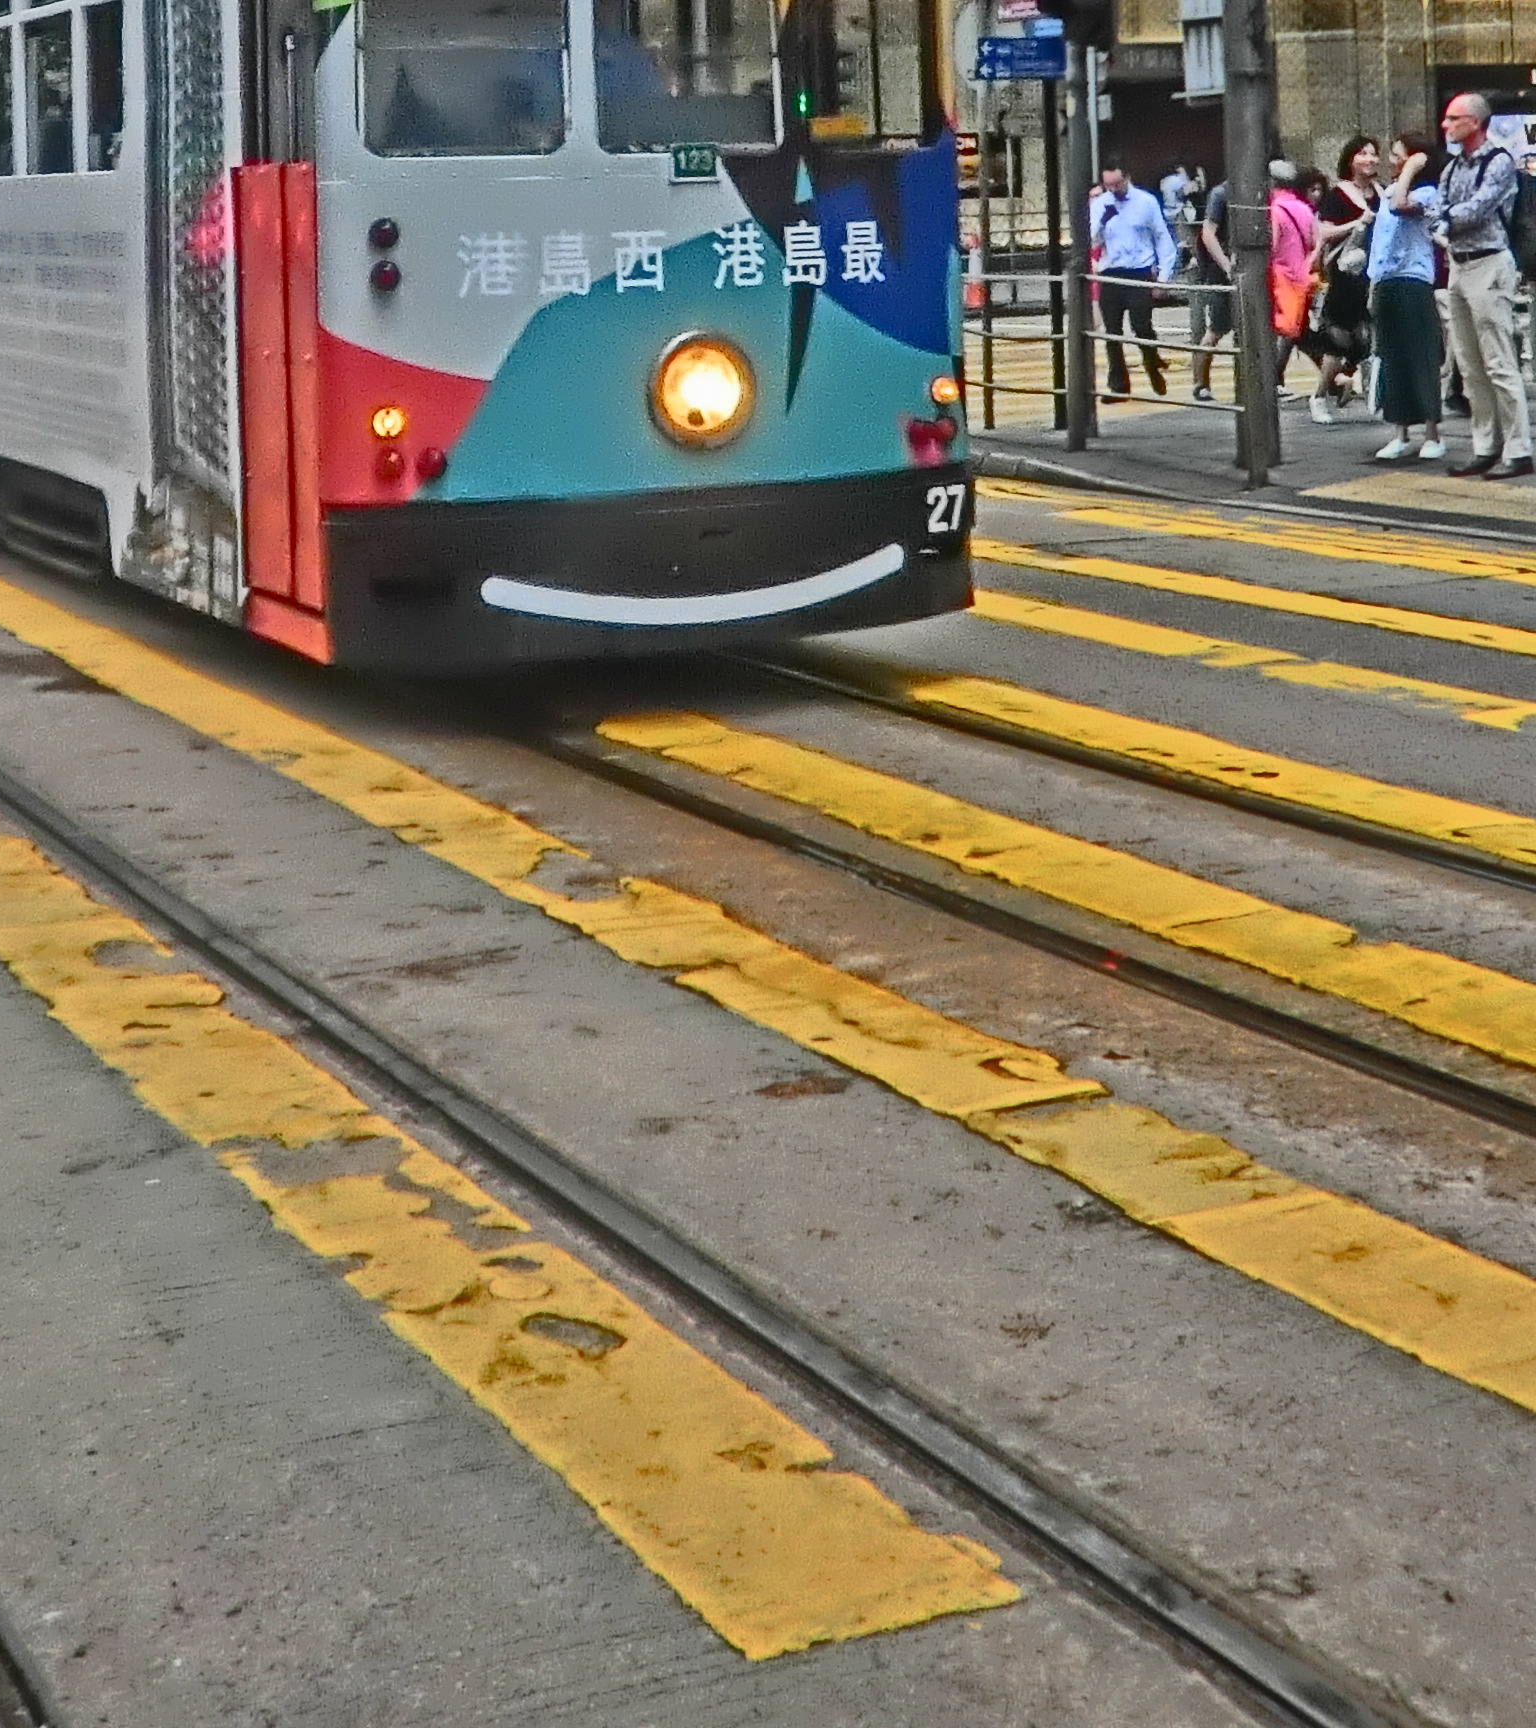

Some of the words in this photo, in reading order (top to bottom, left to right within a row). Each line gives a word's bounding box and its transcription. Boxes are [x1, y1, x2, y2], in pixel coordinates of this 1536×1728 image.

[457, 230, 665, 298] 港島西
[712, 220, 888, 290] 港島最
[925, 483, 966, 534] 27
